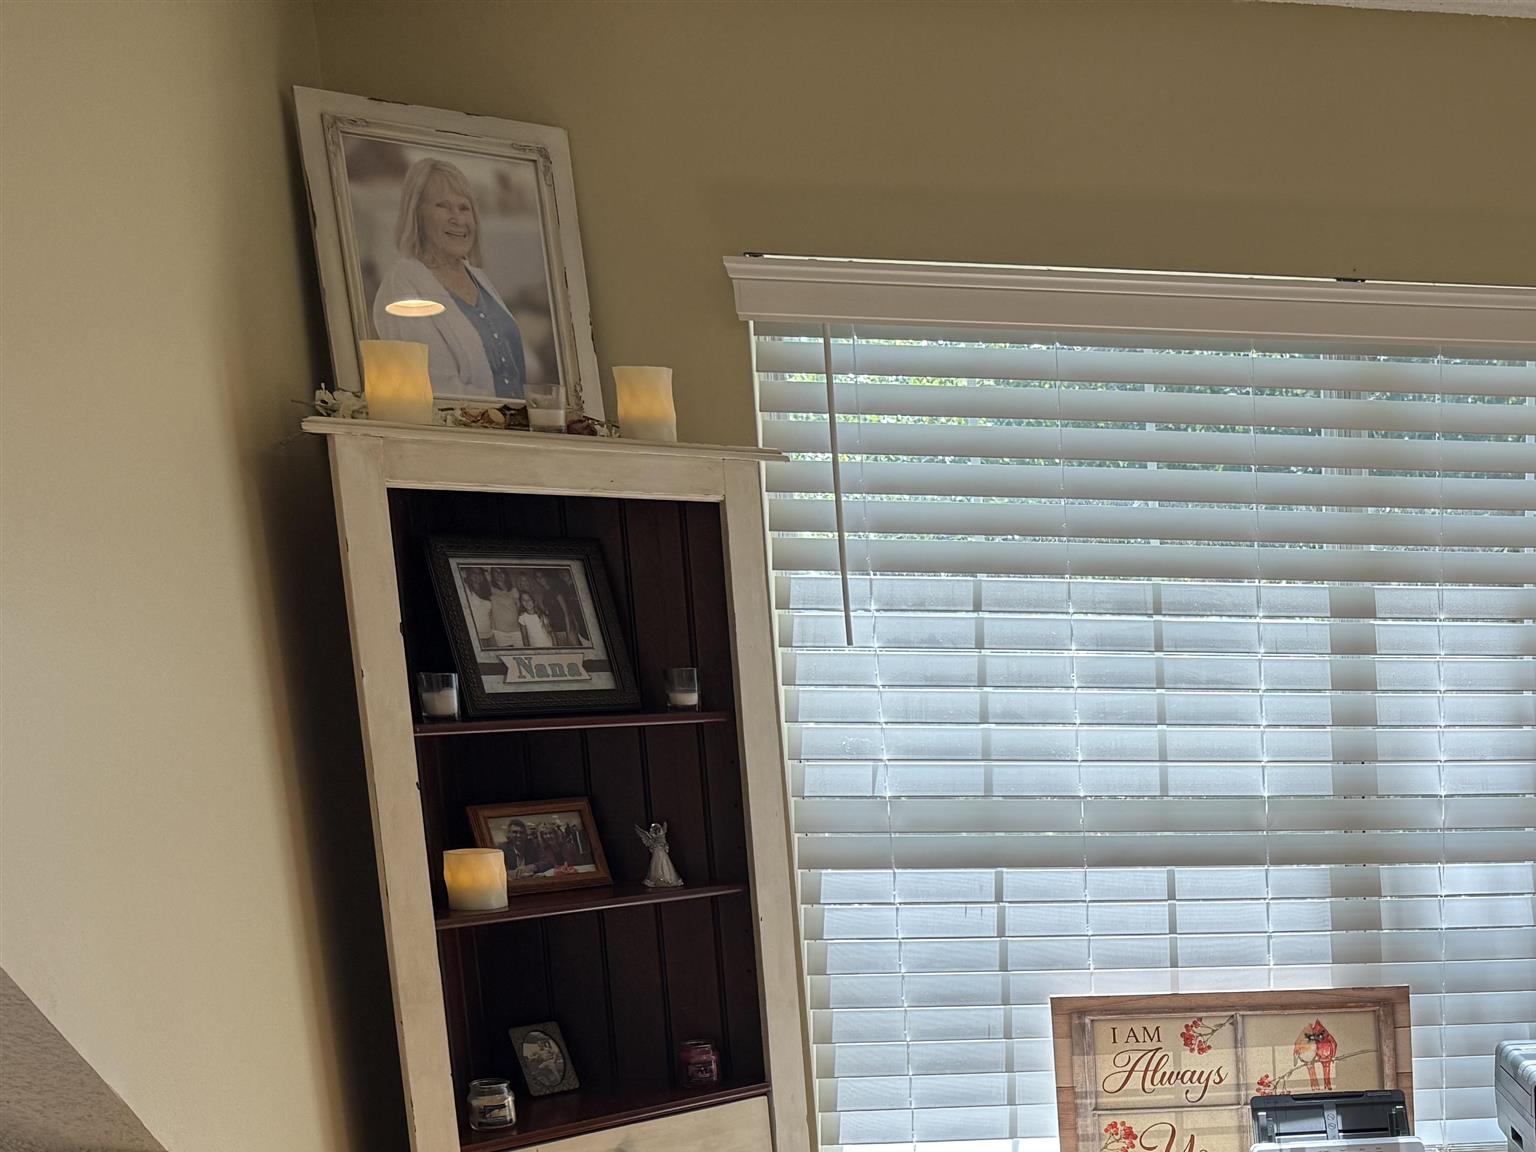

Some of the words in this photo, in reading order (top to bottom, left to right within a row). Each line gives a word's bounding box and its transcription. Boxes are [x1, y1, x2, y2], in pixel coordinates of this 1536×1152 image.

[512, 656, 582, 679] Nana
[1111, 1027, 1118, 1044] I
[1125, 1026, 1163, 1044] AM
[1102, 1047, 1228, 1103] Always
